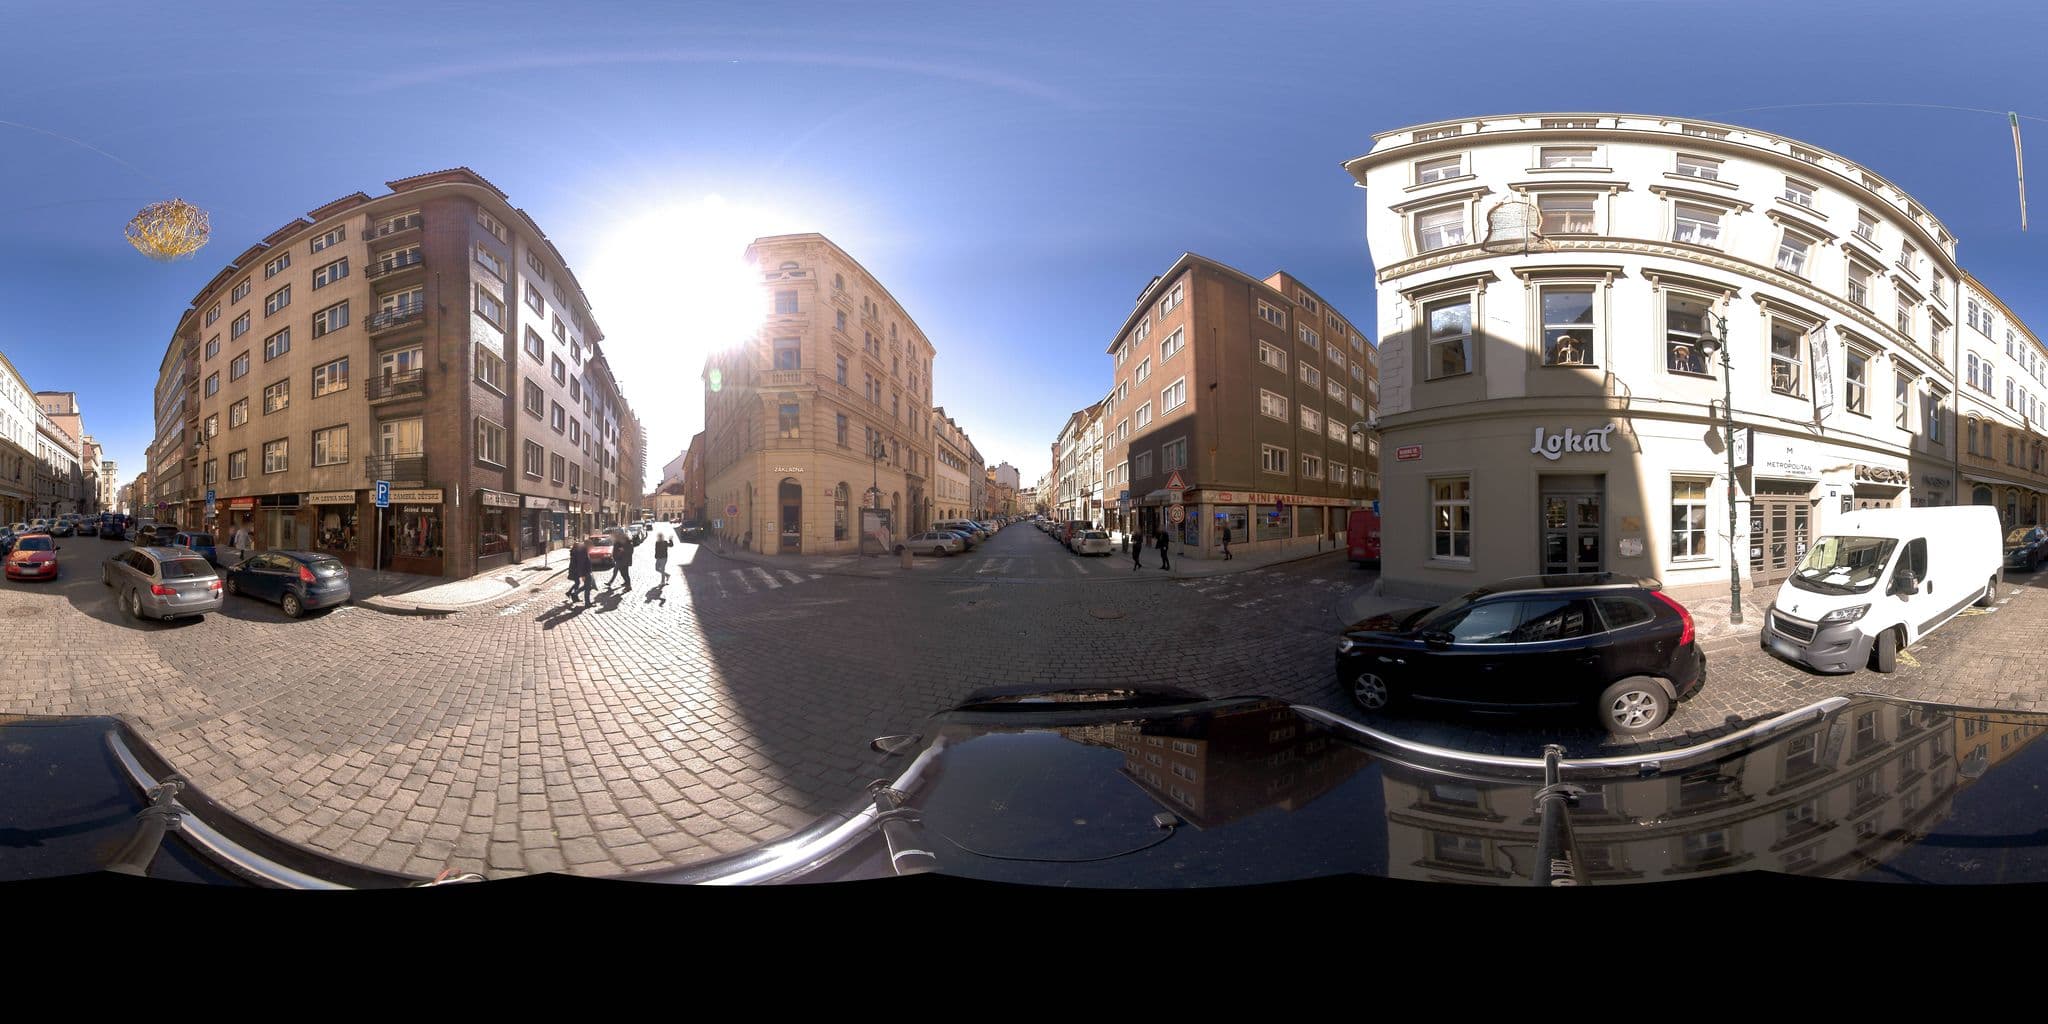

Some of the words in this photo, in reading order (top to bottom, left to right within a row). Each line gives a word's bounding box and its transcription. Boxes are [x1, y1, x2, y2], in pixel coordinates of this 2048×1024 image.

[1530, 422, 1616, 460] Lokal
[1766, 461, 1812, 471] METROPOLITAN
[1855, 464, 1909, 485] ROXY
[379, 484, 387, 499] P
[1248, 493, 1270, 503] MINI
[1274, 494, 1304, 504] MARKET
[1173, 509, 1182, 518] 20
